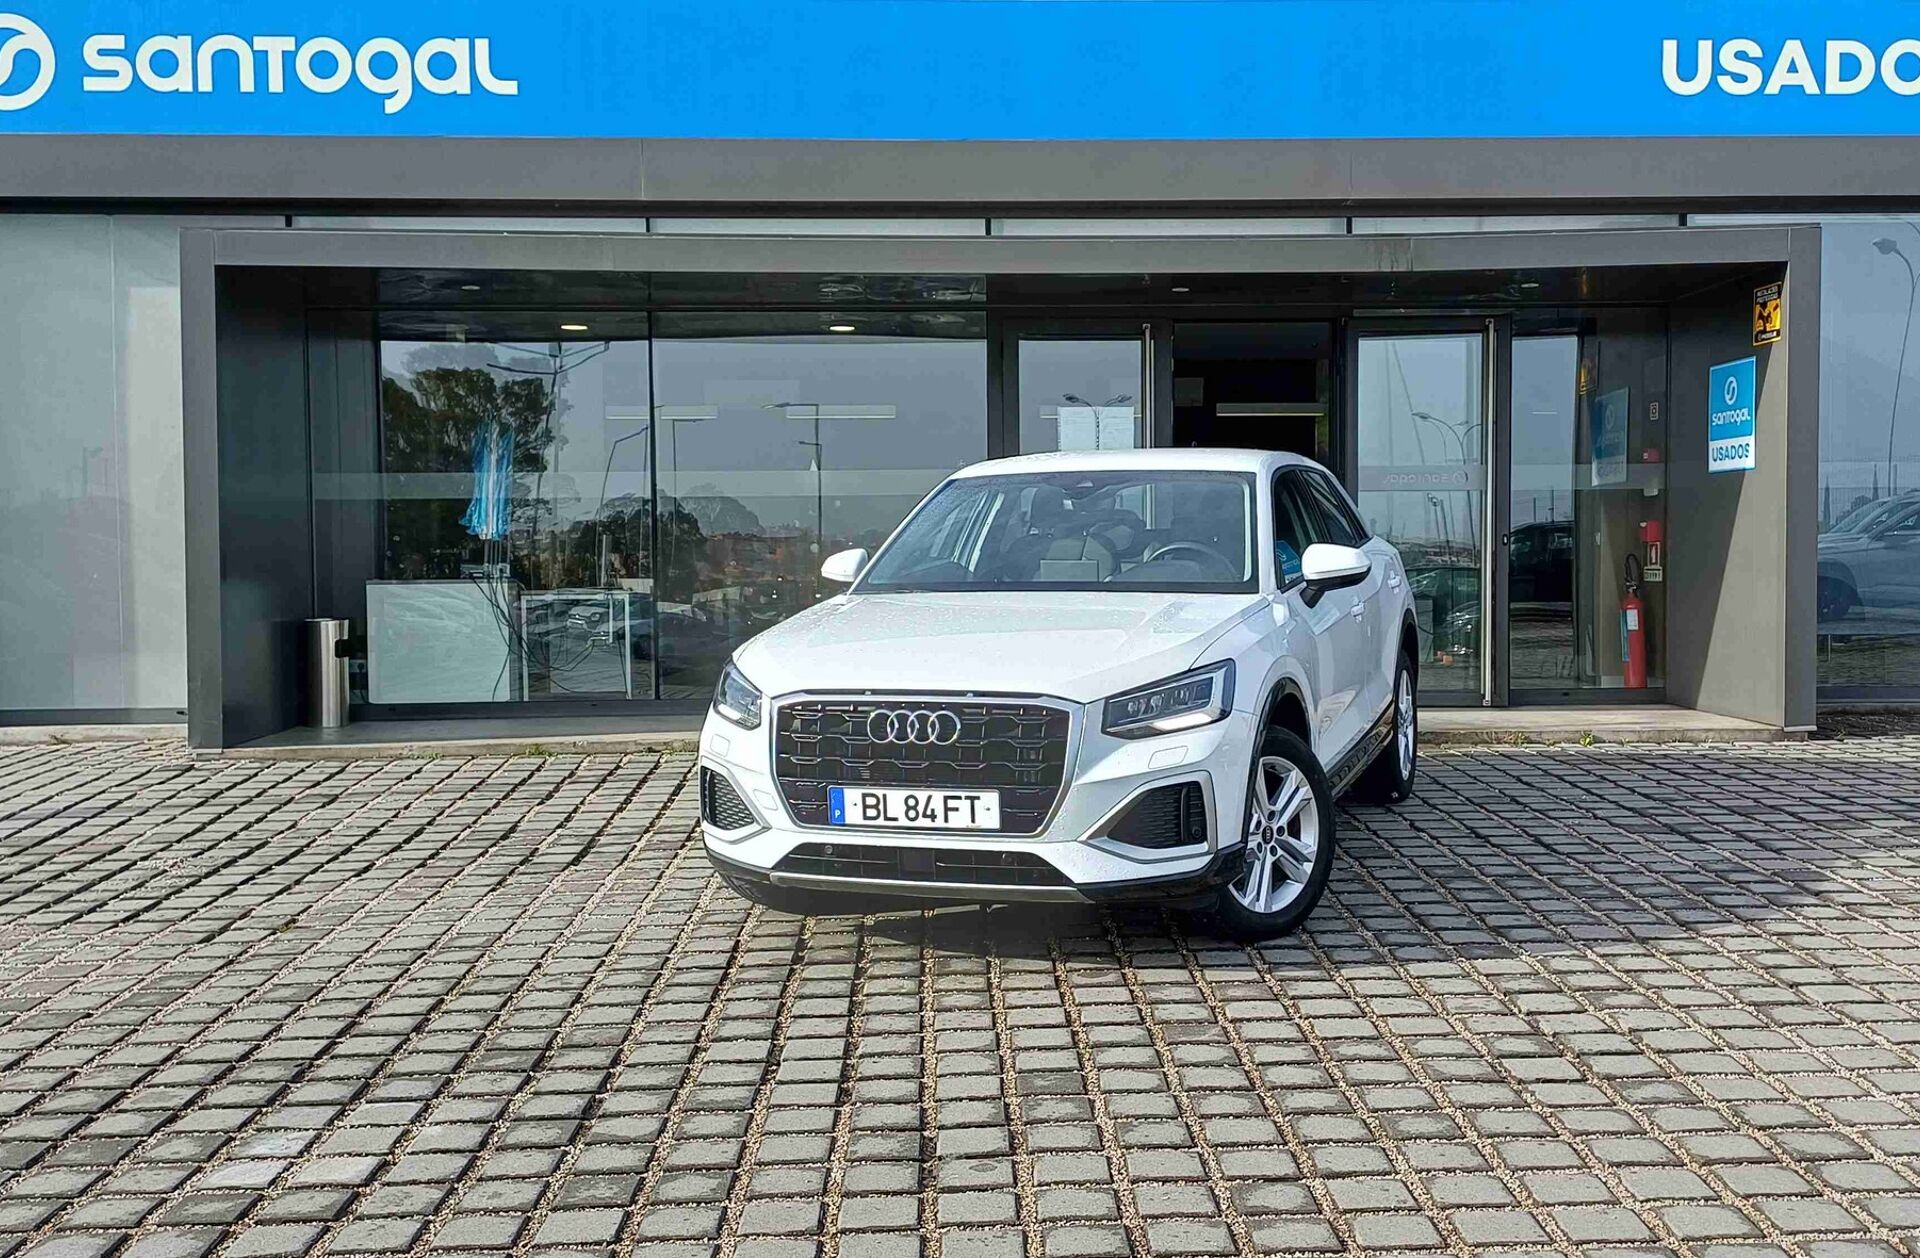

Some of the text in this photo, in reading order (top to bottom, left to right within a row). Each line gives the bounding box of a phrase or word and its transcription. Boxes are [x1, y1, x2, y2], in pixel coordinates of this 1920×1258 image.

[1662, 38, 1920, 95] USADO
[1712, 443, 1750, 462] USADOS
[834, 809, 841, 818] P
[861, 792, 981, 824] BL 84 FT
